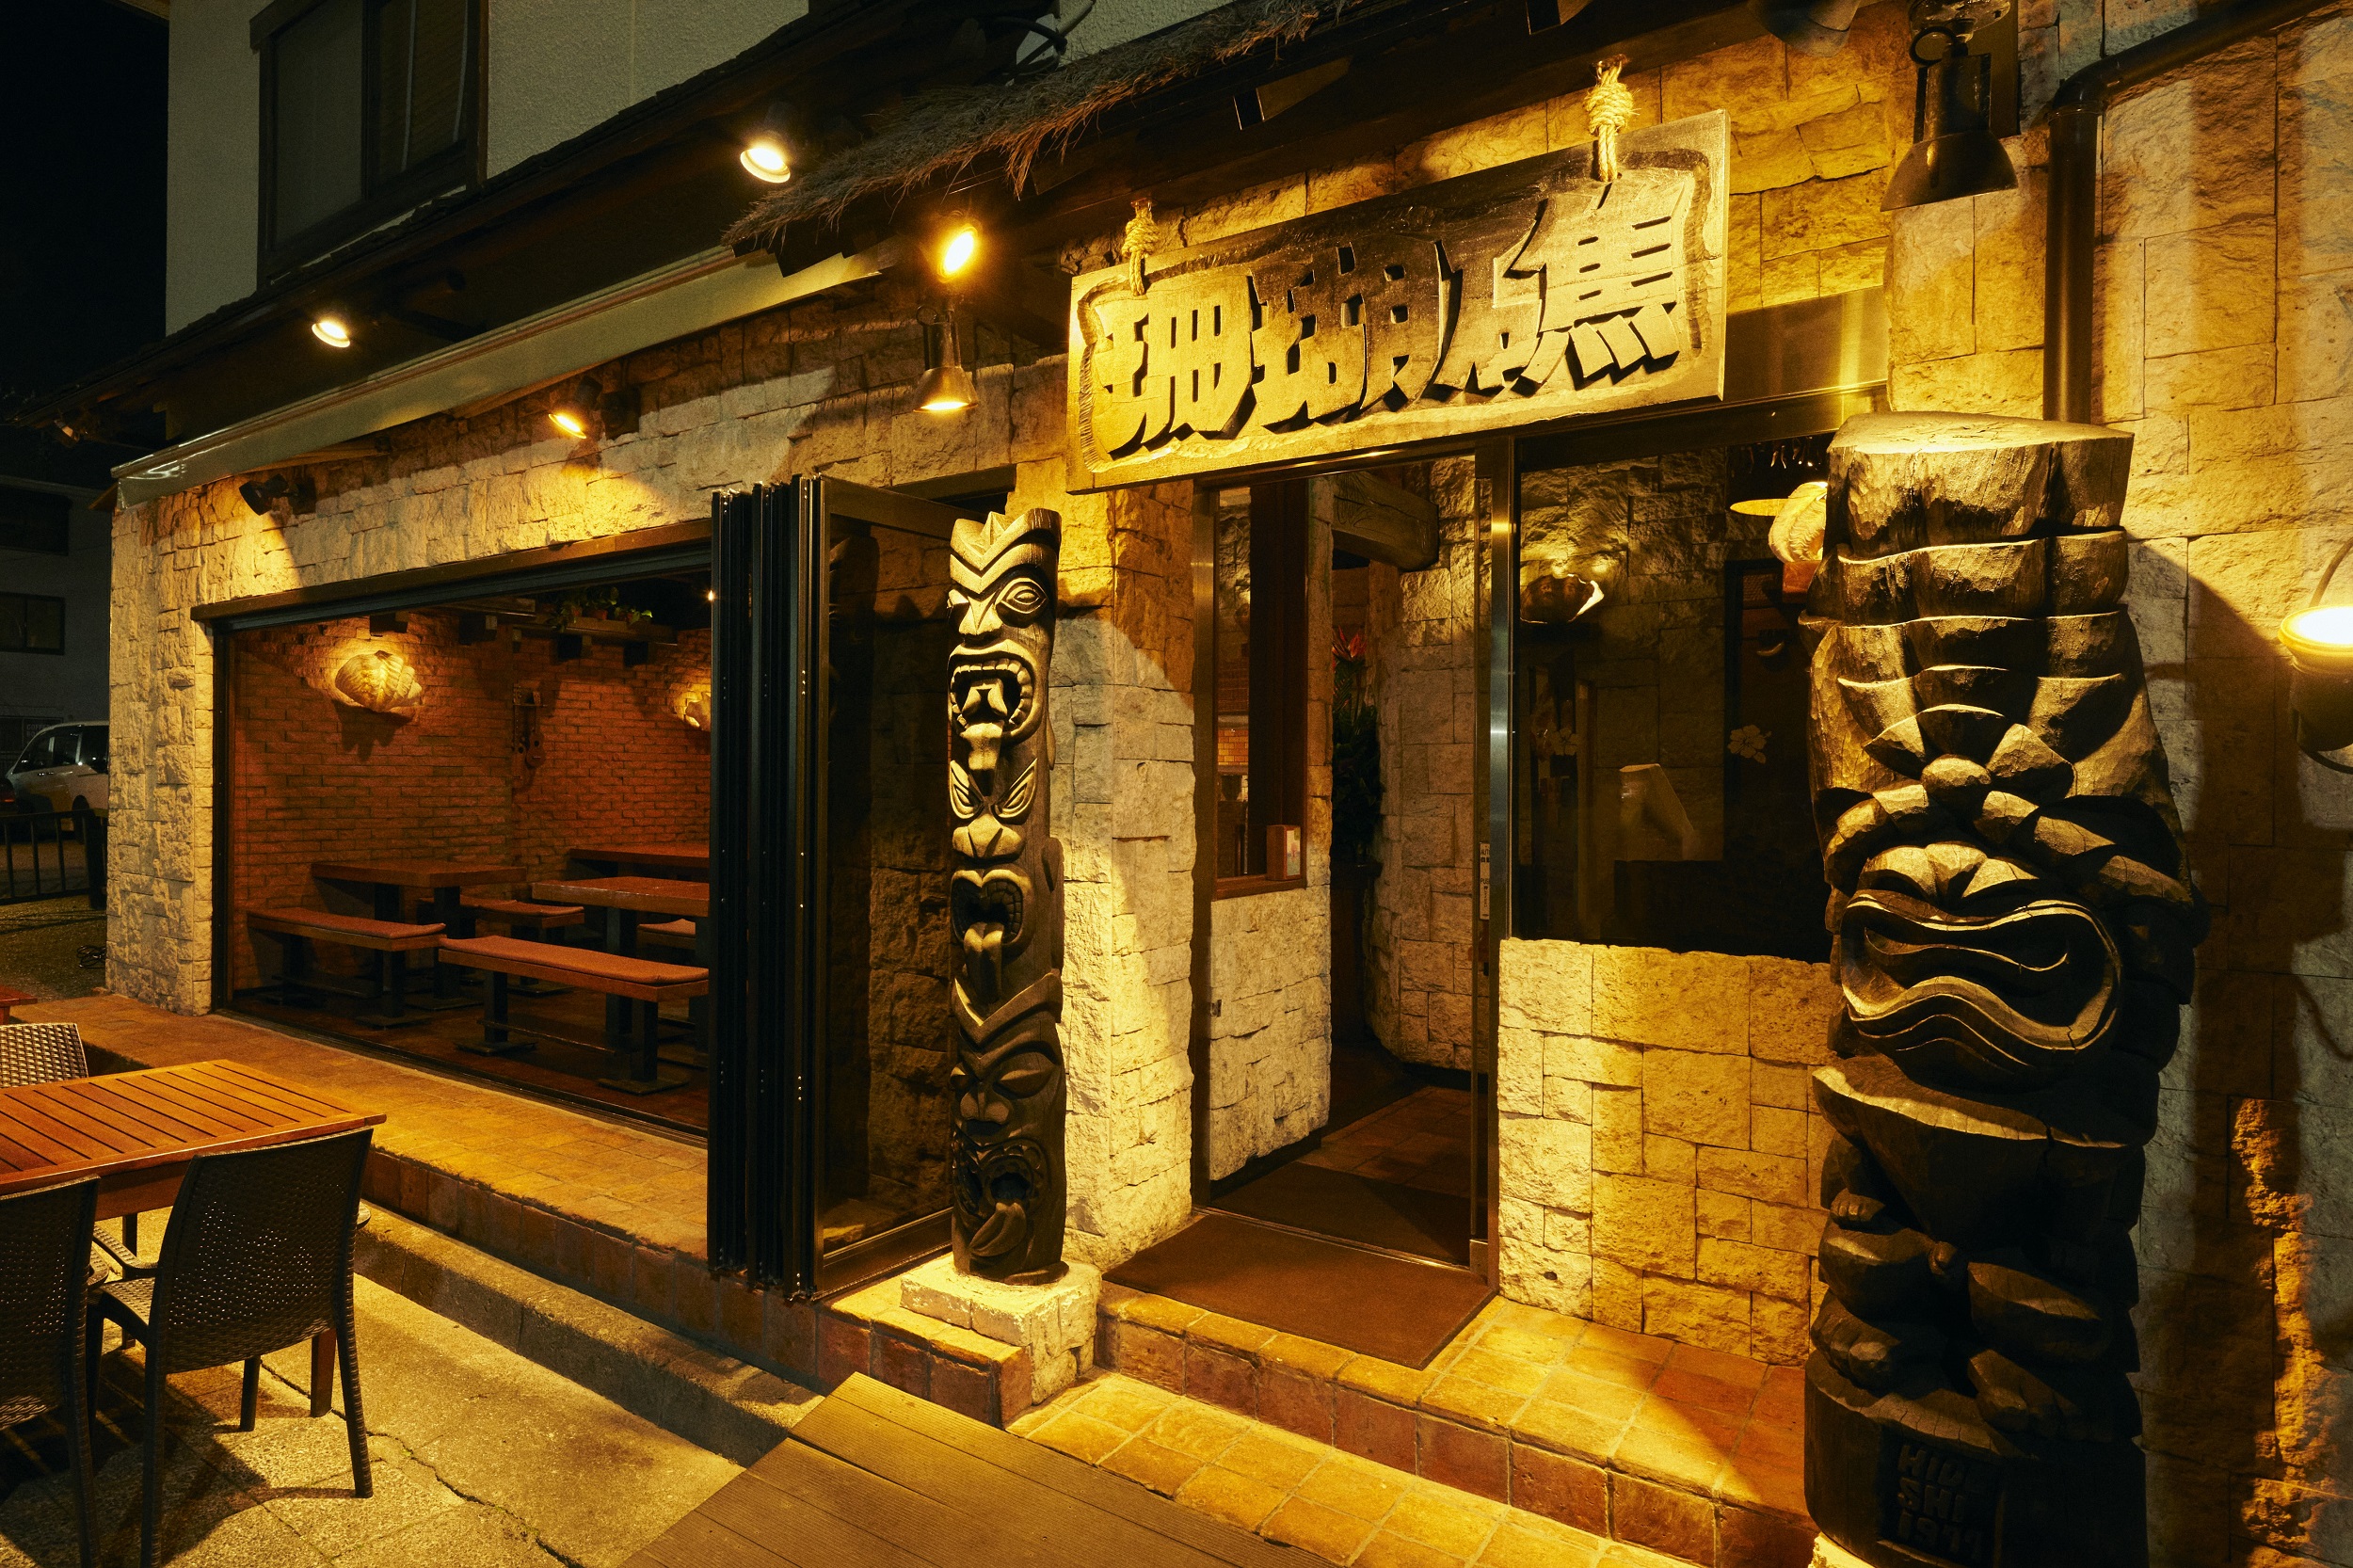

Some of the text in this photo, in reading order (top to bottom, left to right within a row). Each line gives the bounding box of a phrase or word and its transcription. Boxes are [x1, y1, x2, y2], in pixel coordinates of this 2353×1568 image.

[1095, 179, 1683, 459] 珊瑚礁
[1897, 1476, 1966, 1523] SHI
